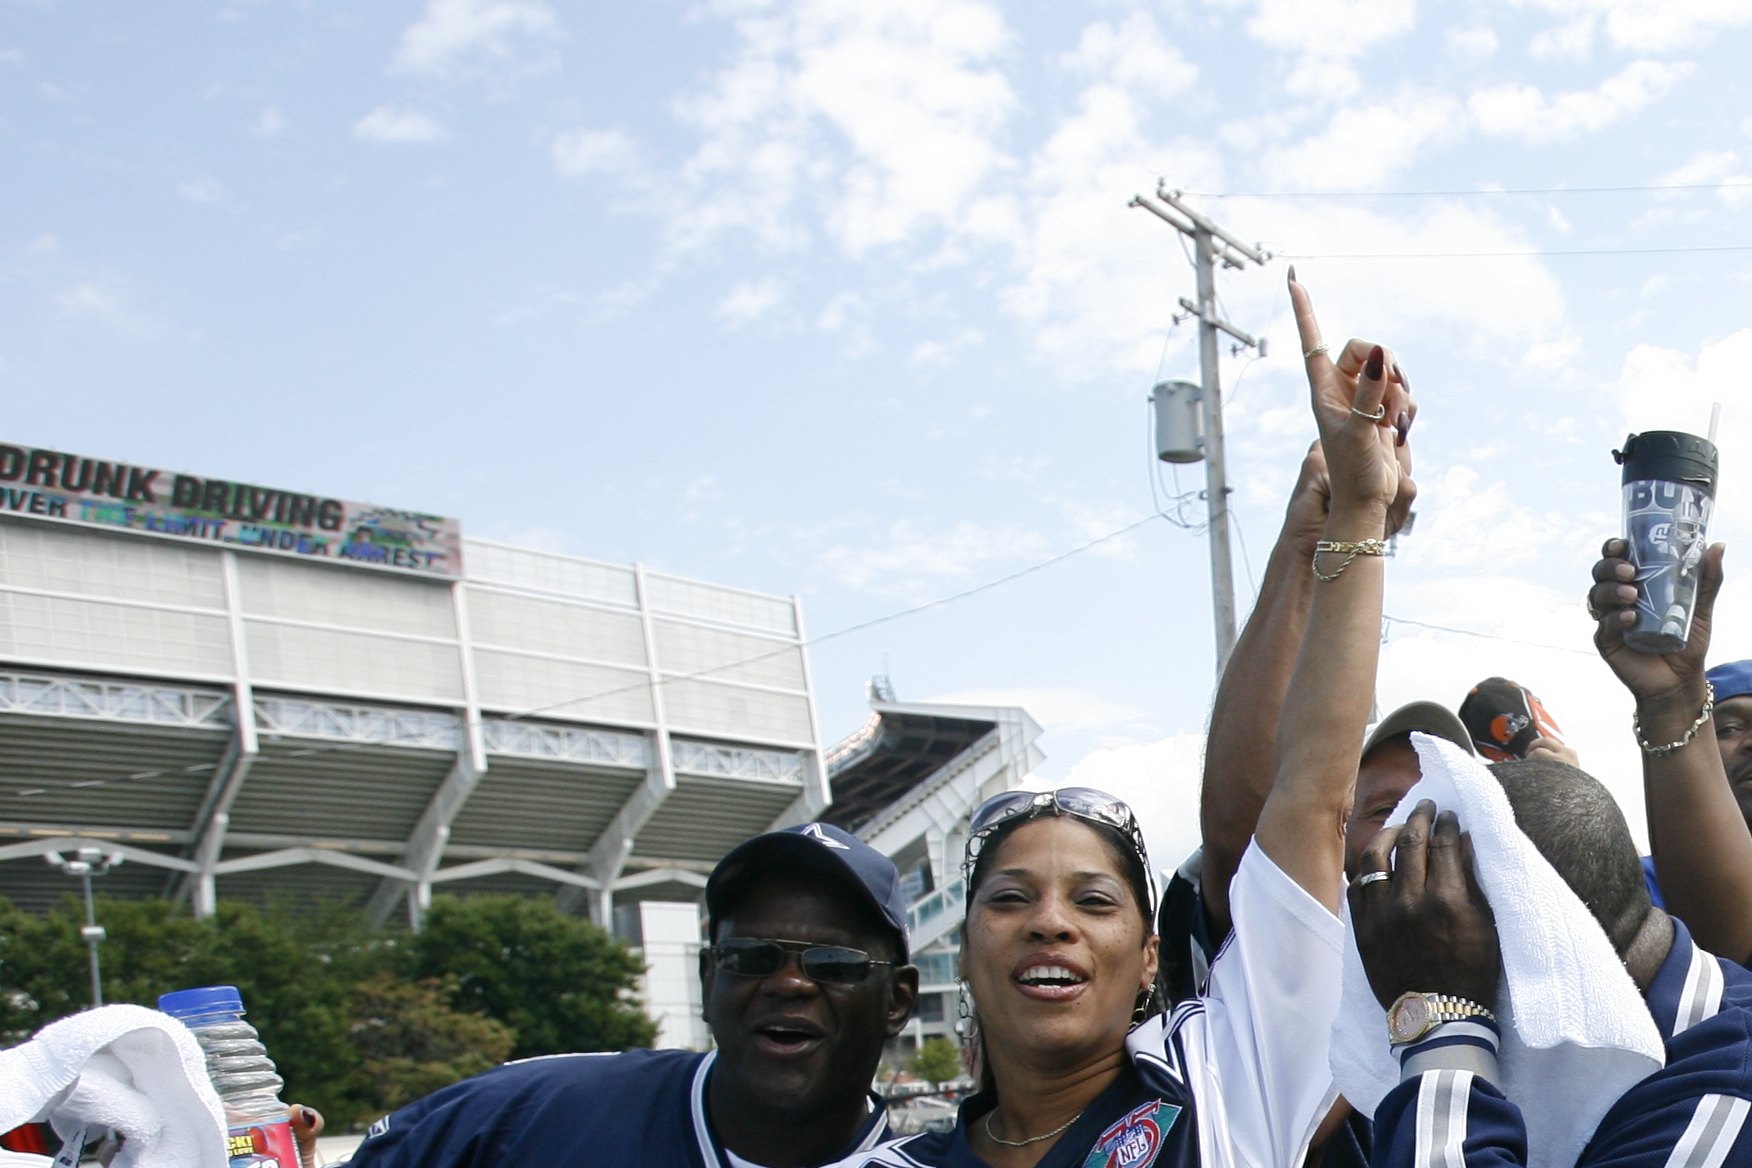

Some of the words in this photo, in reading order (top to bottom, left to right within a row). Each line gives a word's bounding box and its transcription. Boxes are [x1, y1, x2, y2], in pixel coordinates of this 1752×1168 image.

[0, 445, 161, 504] DRUNK
[172, 474, 346, 531] DRIVING
[1119, 1137, 1149, 1164] NFL
